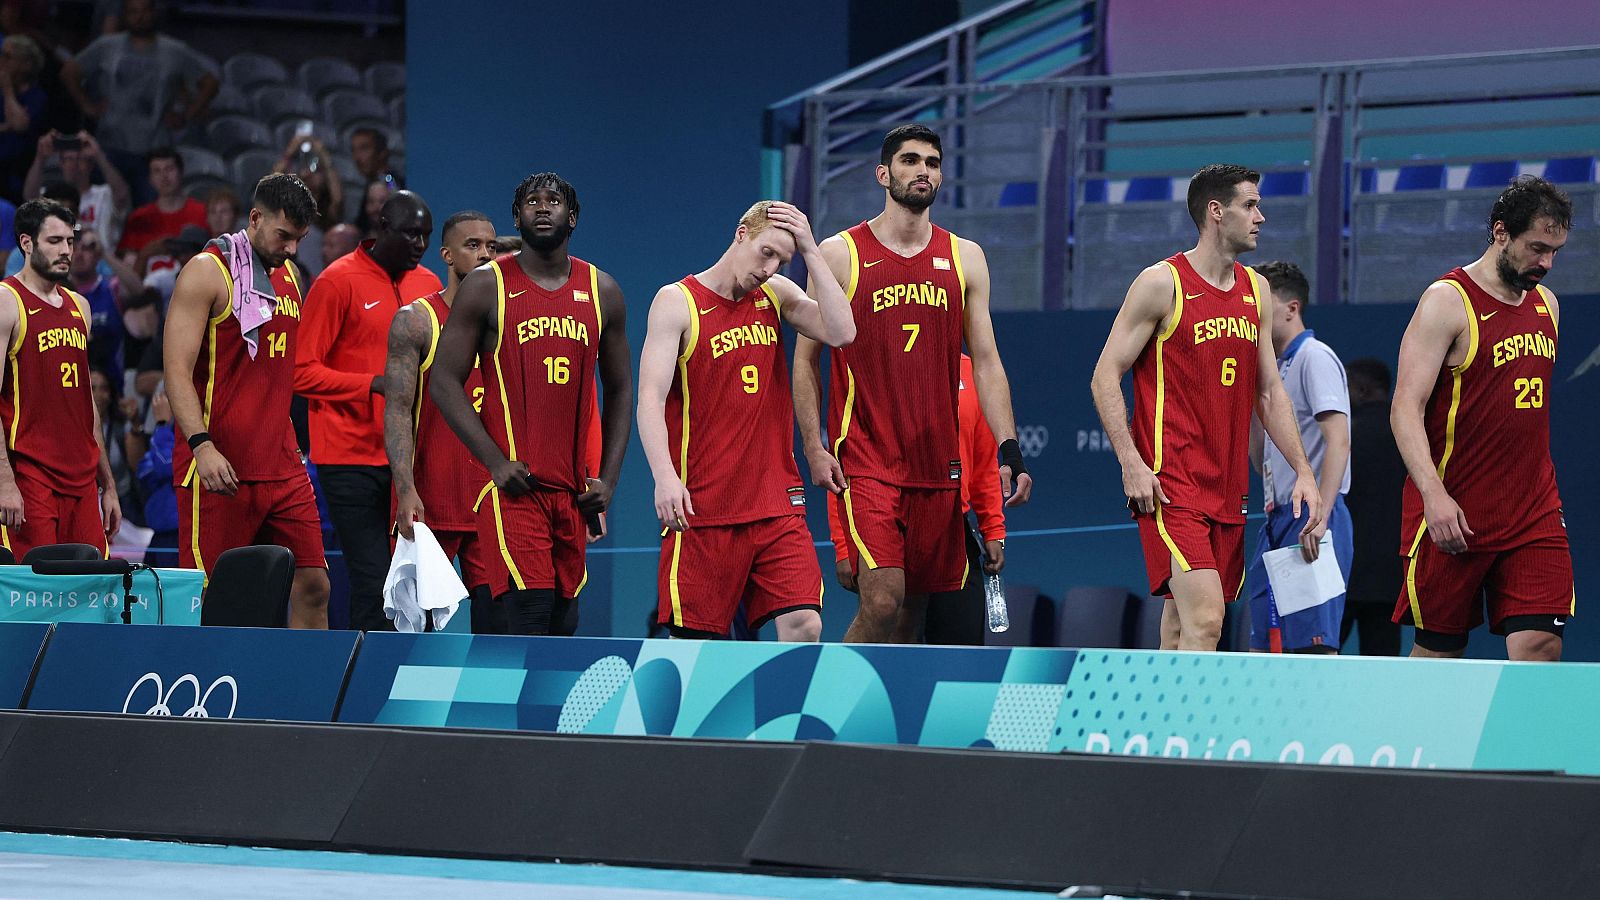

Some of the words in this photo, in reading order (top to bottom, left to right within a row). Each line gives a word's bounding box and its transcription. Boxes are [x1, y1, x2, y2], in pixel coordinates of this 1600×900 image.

[275, 295, 300, 322] AÑA
[872, 281, 948, 313] ESPAÑA
[267, 332, 287, 358] 14
[517, 315, 589, 347] ESPAÑA
[709, 321, 778, 360] ESPAÑA
[902, 324, 920, 353] 7
[1193, 315, 1258, 348] ESPAÑA
[1492, 330, 1556, 368] ESPAÑA
[60, 362, 79, 388] 21
[542, 356, 570, 385] 16
[740, 364, 759, 394] 9
[1220, 357, 1237, 387] 6
[472, 386, 485, 413] 2
[1513, 377, 1544, 409] 23
